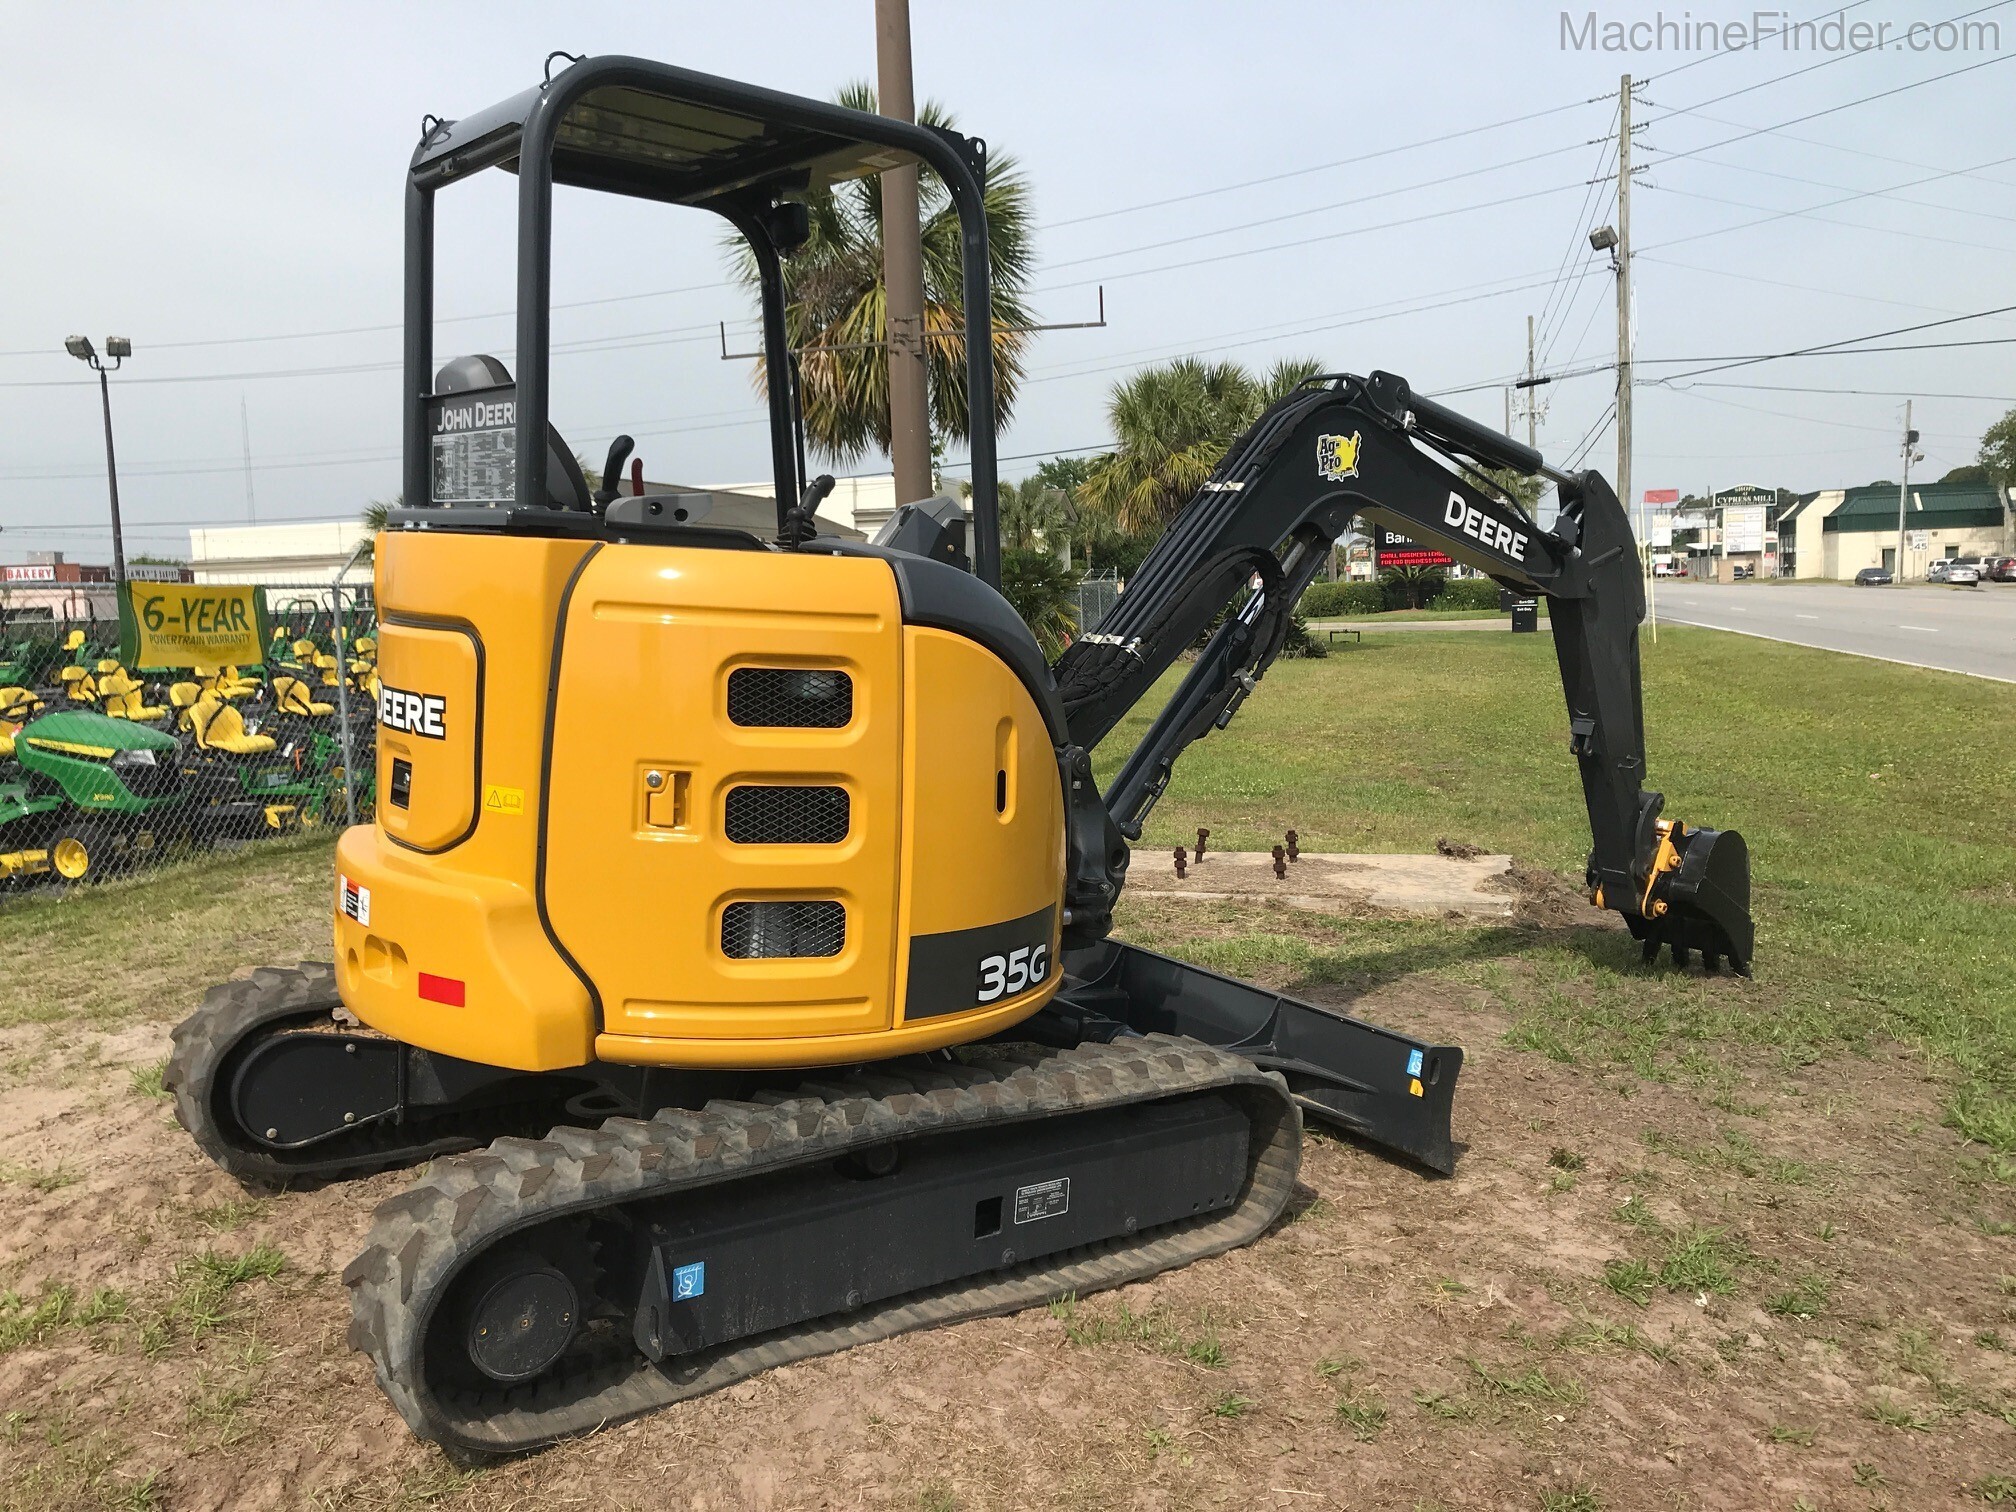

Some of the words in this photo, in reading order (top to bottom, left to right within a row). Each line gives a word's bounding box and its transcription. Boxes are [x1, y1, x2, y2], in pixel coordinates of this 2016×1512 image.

[437, 406, 472, 432] JOHN
[475, 401, 516, 428] DEER
[1320, 454, 1342, 472] Pro
[1717, 496, 1752, 504] CYPRESS
[1753, 494, 1774, 502] MILL
[1443, 490, 1529, 563] DEERE
[7, 567, 52, 580] BAKERY
[142, 596, 251, 633] 6-YEAR
[149, 633, 205, 646] POWERTRAIN
[206, 633, 251, 645] WARRANTY
[977, 943, 1047, 1002] 35G
